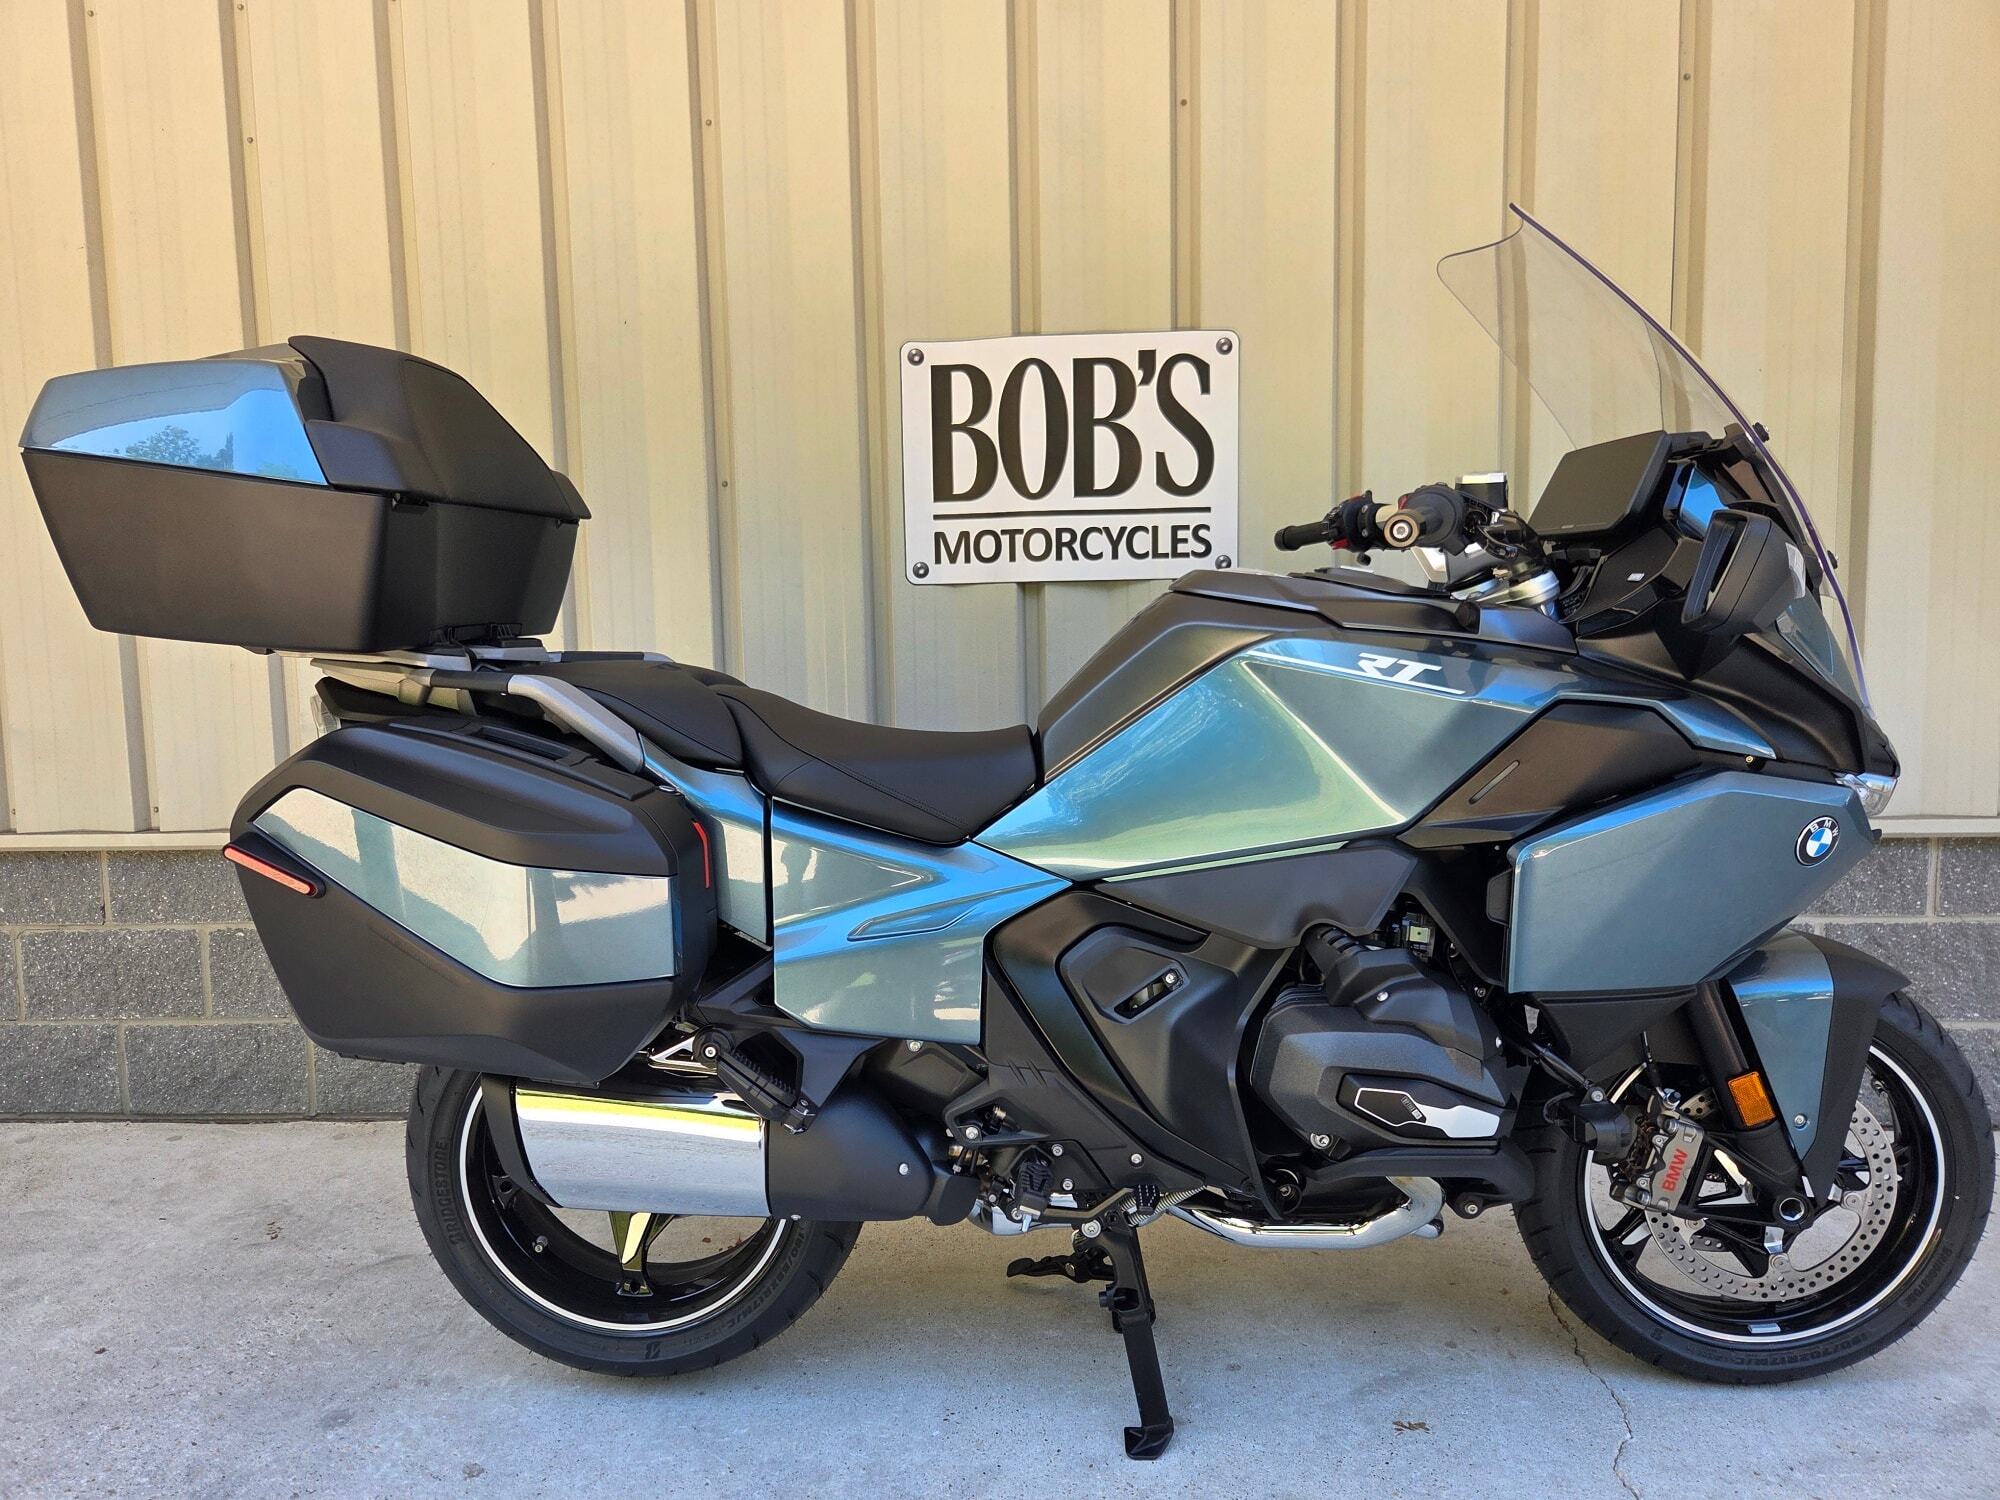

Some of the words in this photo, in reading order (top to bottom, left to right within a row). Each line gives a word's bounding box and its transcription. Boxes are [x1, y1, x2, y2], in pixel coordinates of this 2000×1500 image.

[930, 348, 1215, 503] BOB'S
[933, 524, 1213, 565] MOTORCYCLES
[1358, 652, 1442, 682] RT
[1809, 819, 1839, 837] BMW
[1662, 1148, 1688, 1191] BMW
[434, 1139, 462, 1245] BRIDGESTONE
